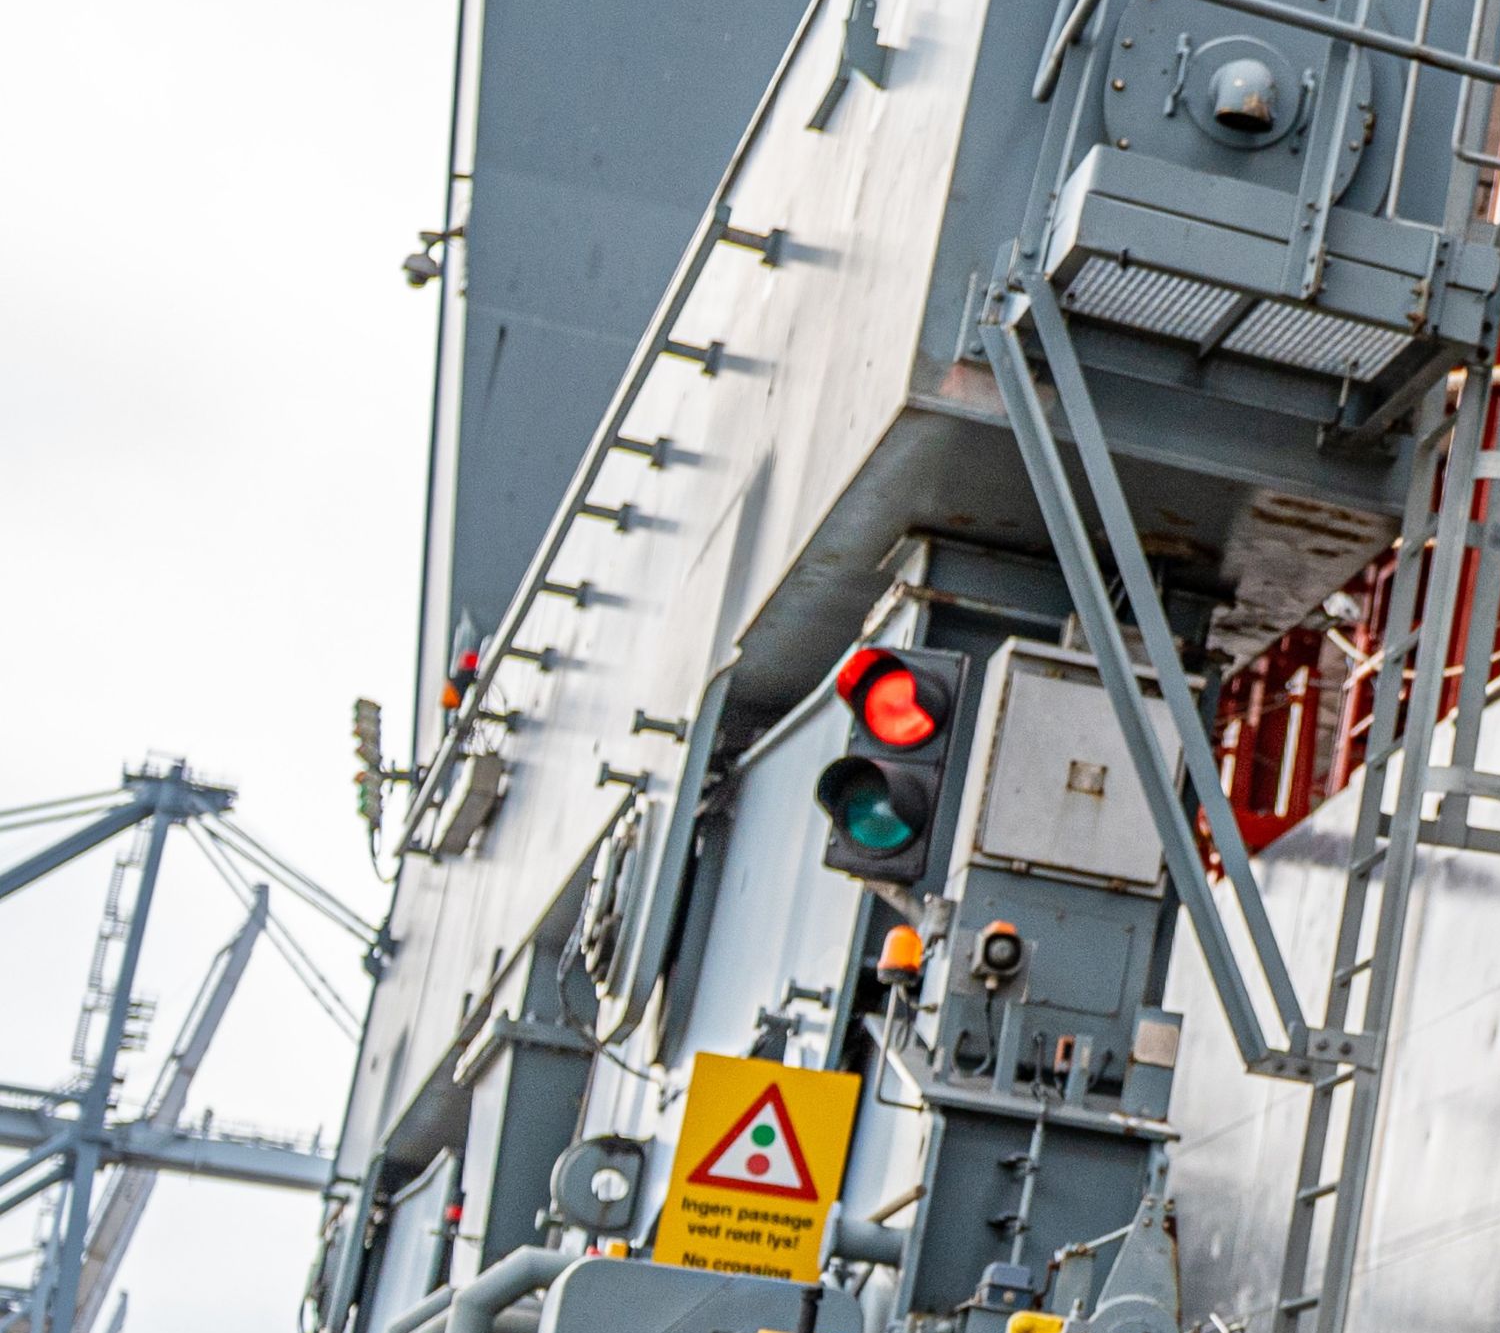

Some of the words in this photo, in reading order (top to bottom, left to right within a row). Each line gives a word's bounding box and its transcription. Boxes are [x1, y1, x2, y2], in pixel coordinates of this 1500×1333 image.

[682, 1196, 732, 1218] Ingen
[737, 1207, 814, 1231] passage
[688, 1222, 721, 1238] ved
[767, 1232, 799, 1251] lys!
[682, 1252, 707, 1268] No
